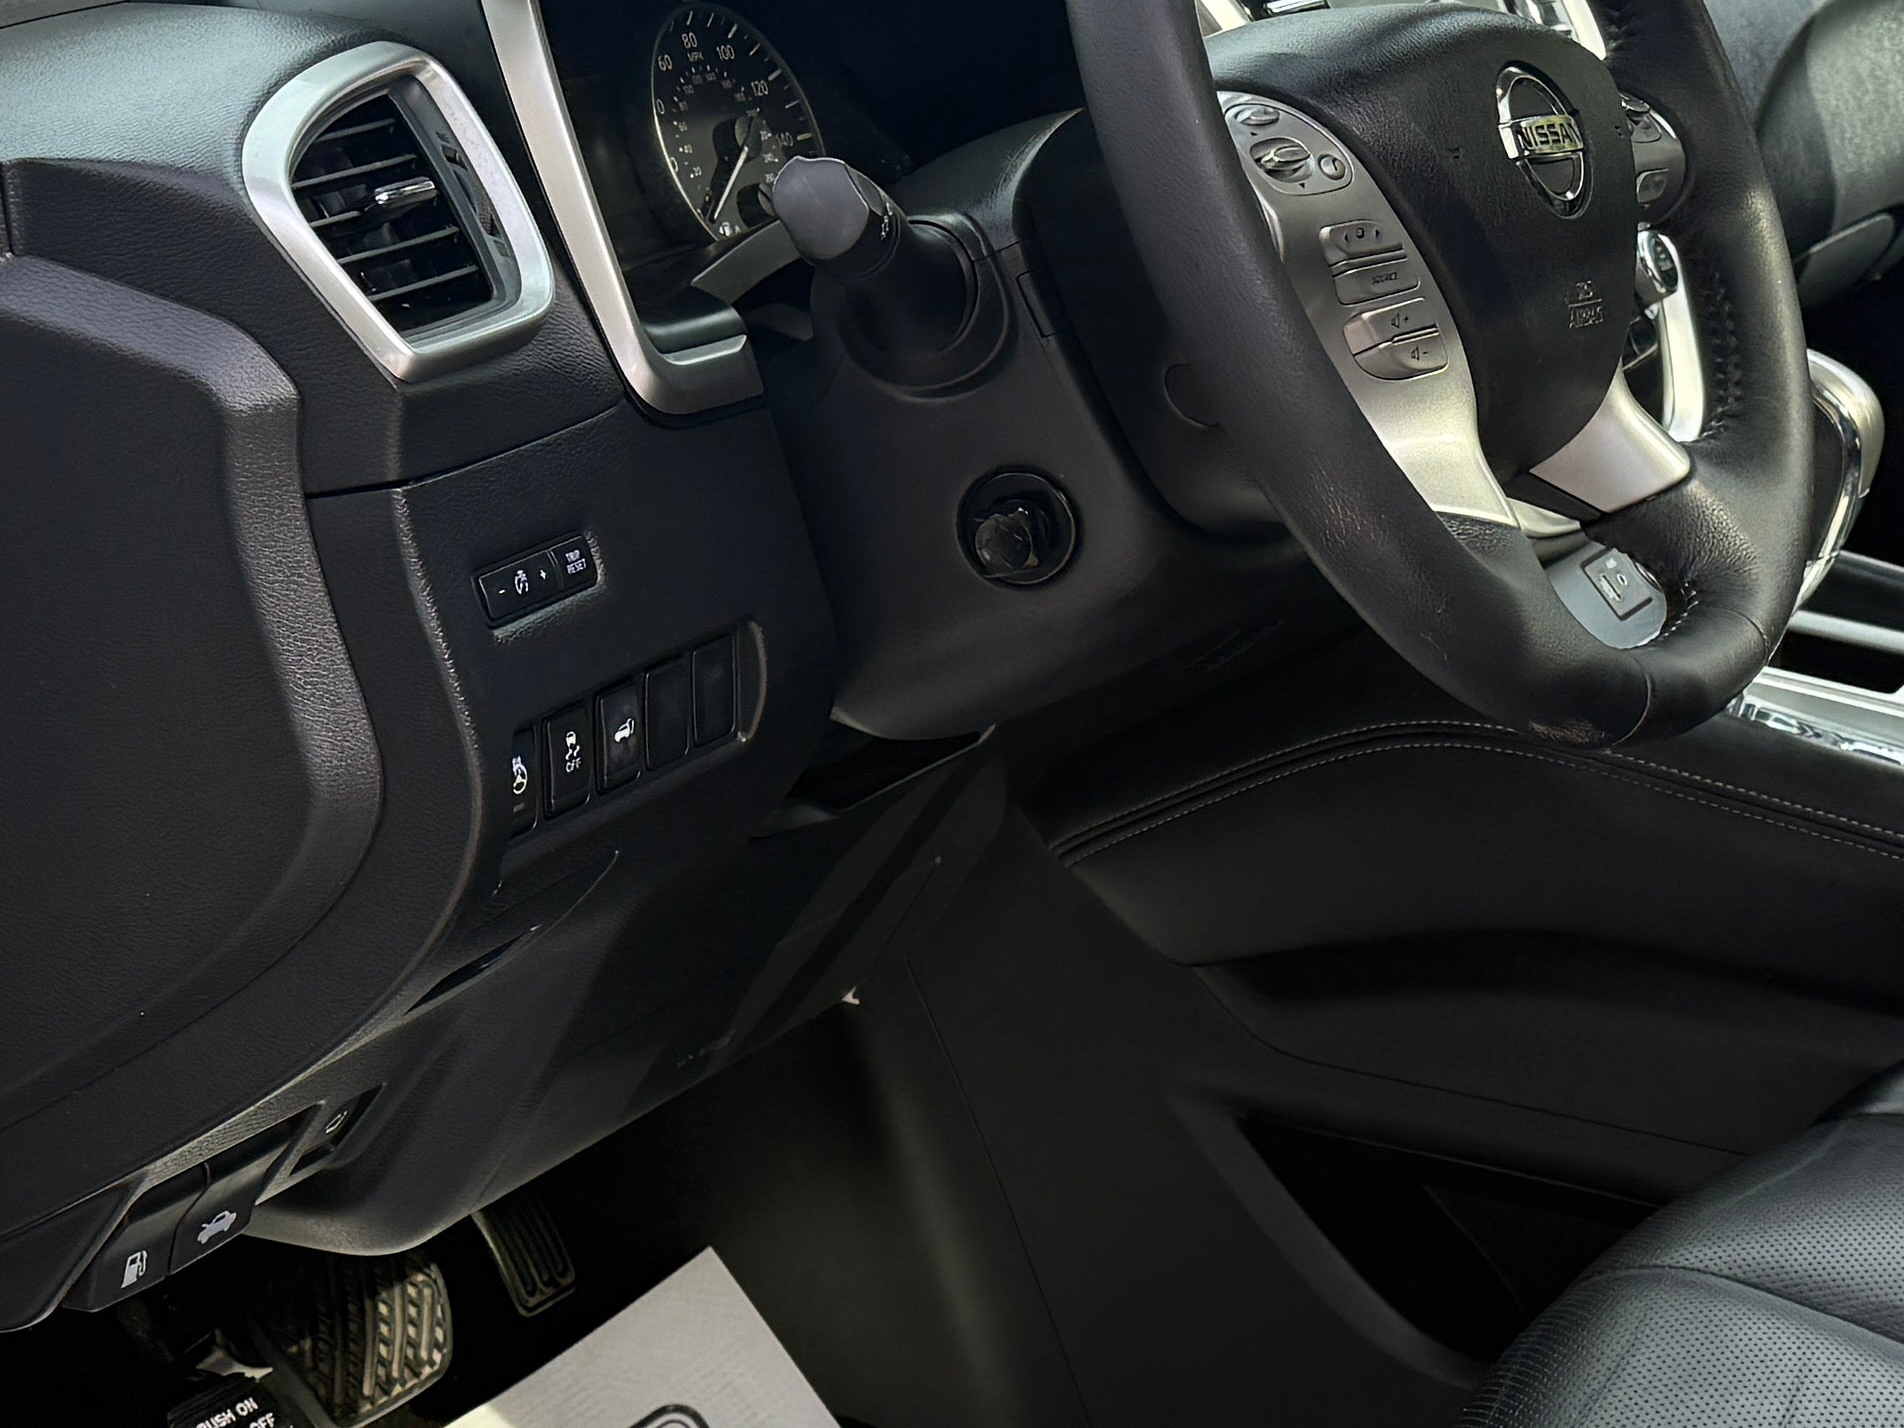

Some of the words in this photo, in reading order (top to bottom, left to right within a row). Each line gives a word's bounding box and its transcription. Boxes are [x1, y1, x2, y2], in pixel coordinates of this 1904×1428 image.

[681, 32, 698, 48] 80
[716, 45, 736, 61] 100
[657, 54, 673, 72] 60
[751, 79, 769, 97] 120
[775, 131, 794, 149] 140
[565, 756, 583, 773] OFF
[235, 1396, 259, 1417] ON
